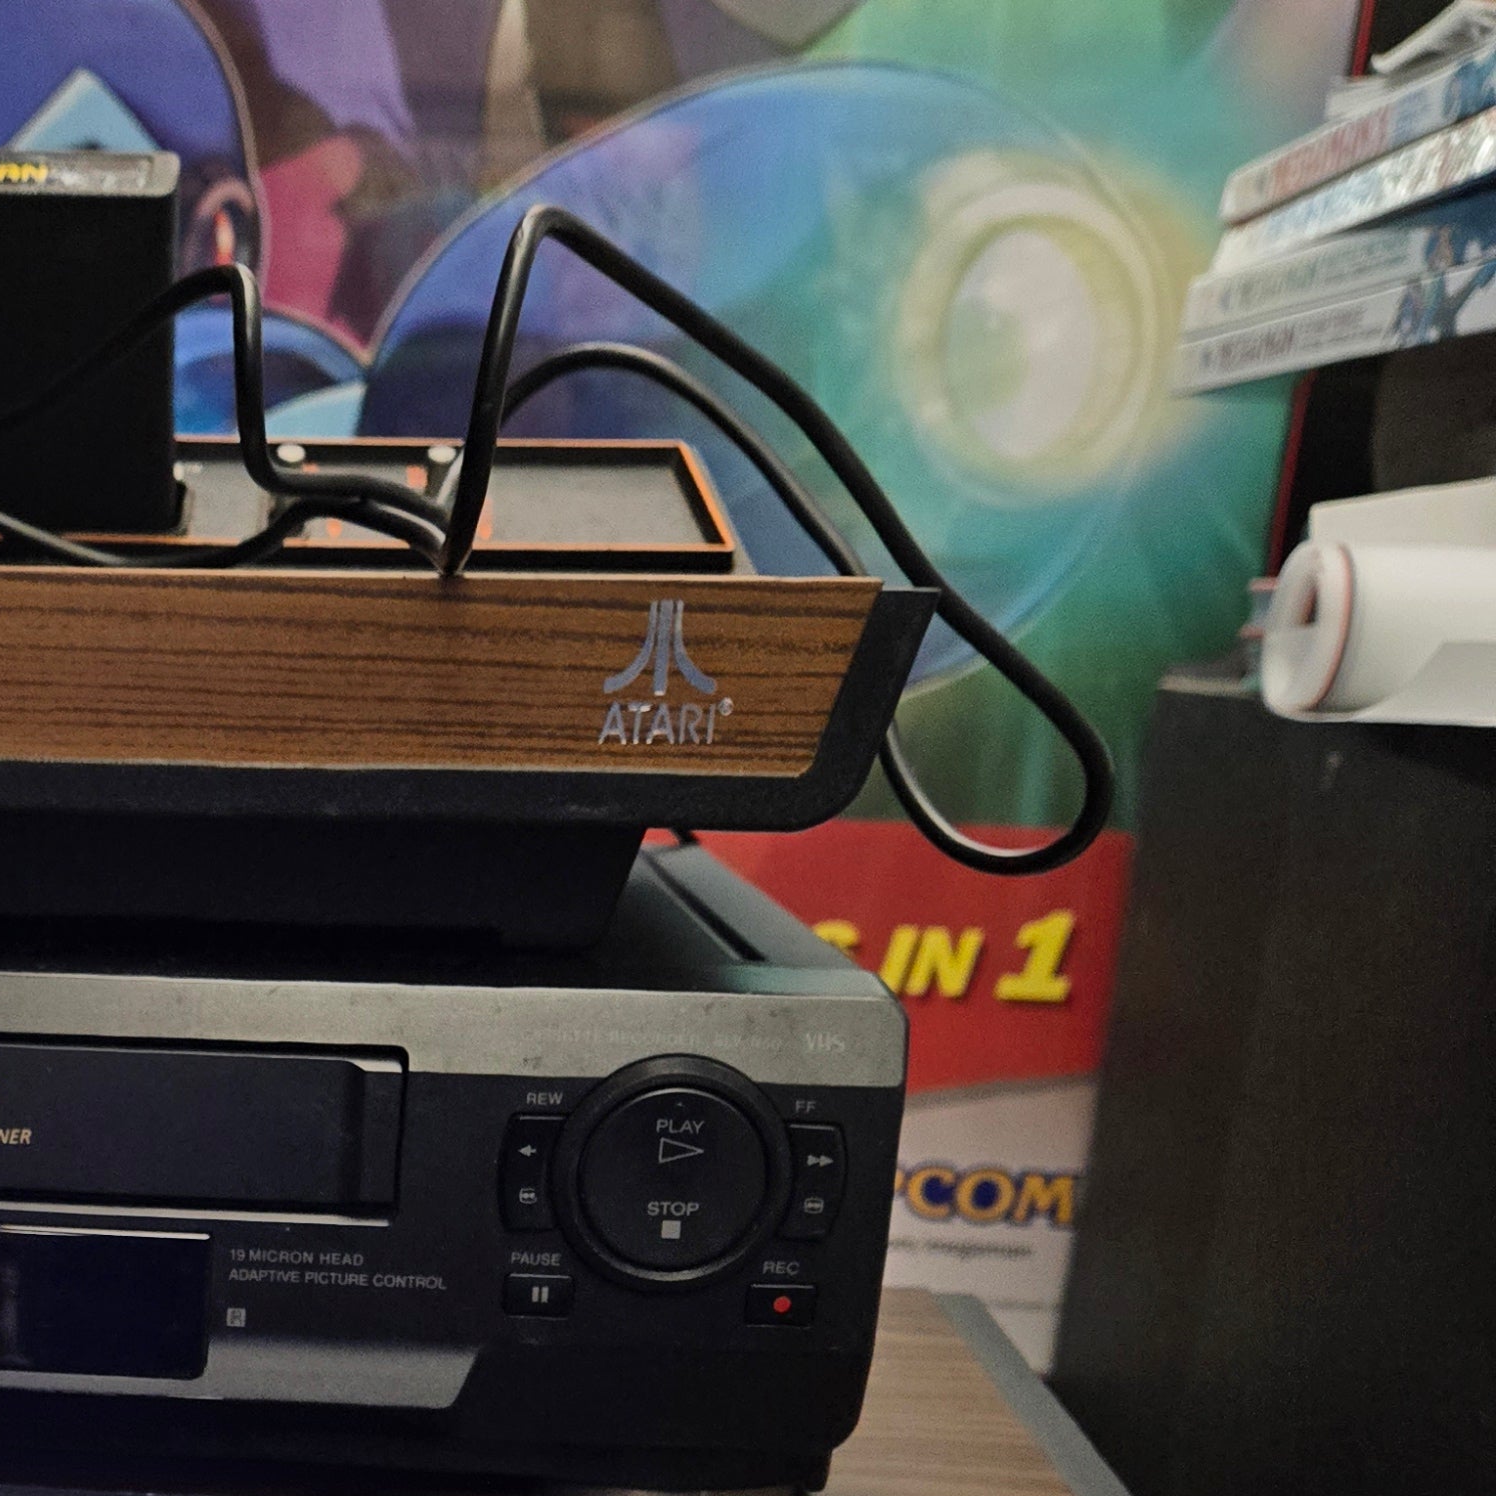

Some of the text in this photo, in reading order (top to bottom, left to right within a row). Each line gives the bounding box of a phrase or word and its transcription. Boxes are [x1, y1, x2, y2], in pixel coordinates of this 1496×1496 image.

[878, 922, 985, 999] IN
[993, 909, 1077, 1003] 1
[525, 1091, 564, 1108] REW
[655, 1118, 705, 1136] PLAY
[895, 1162, 1077, 1227] COM
[646, 1201, 700, 1218] STOP
[229, 1248, 364, 1267] 19 MICRON HEAD
[510, 1251, 561, 1268] PAUSE
[762, 1261, 801, 1276] REC
[228, 1267, 447, 1291] ADAPTIVE PICTURE CONTROL
